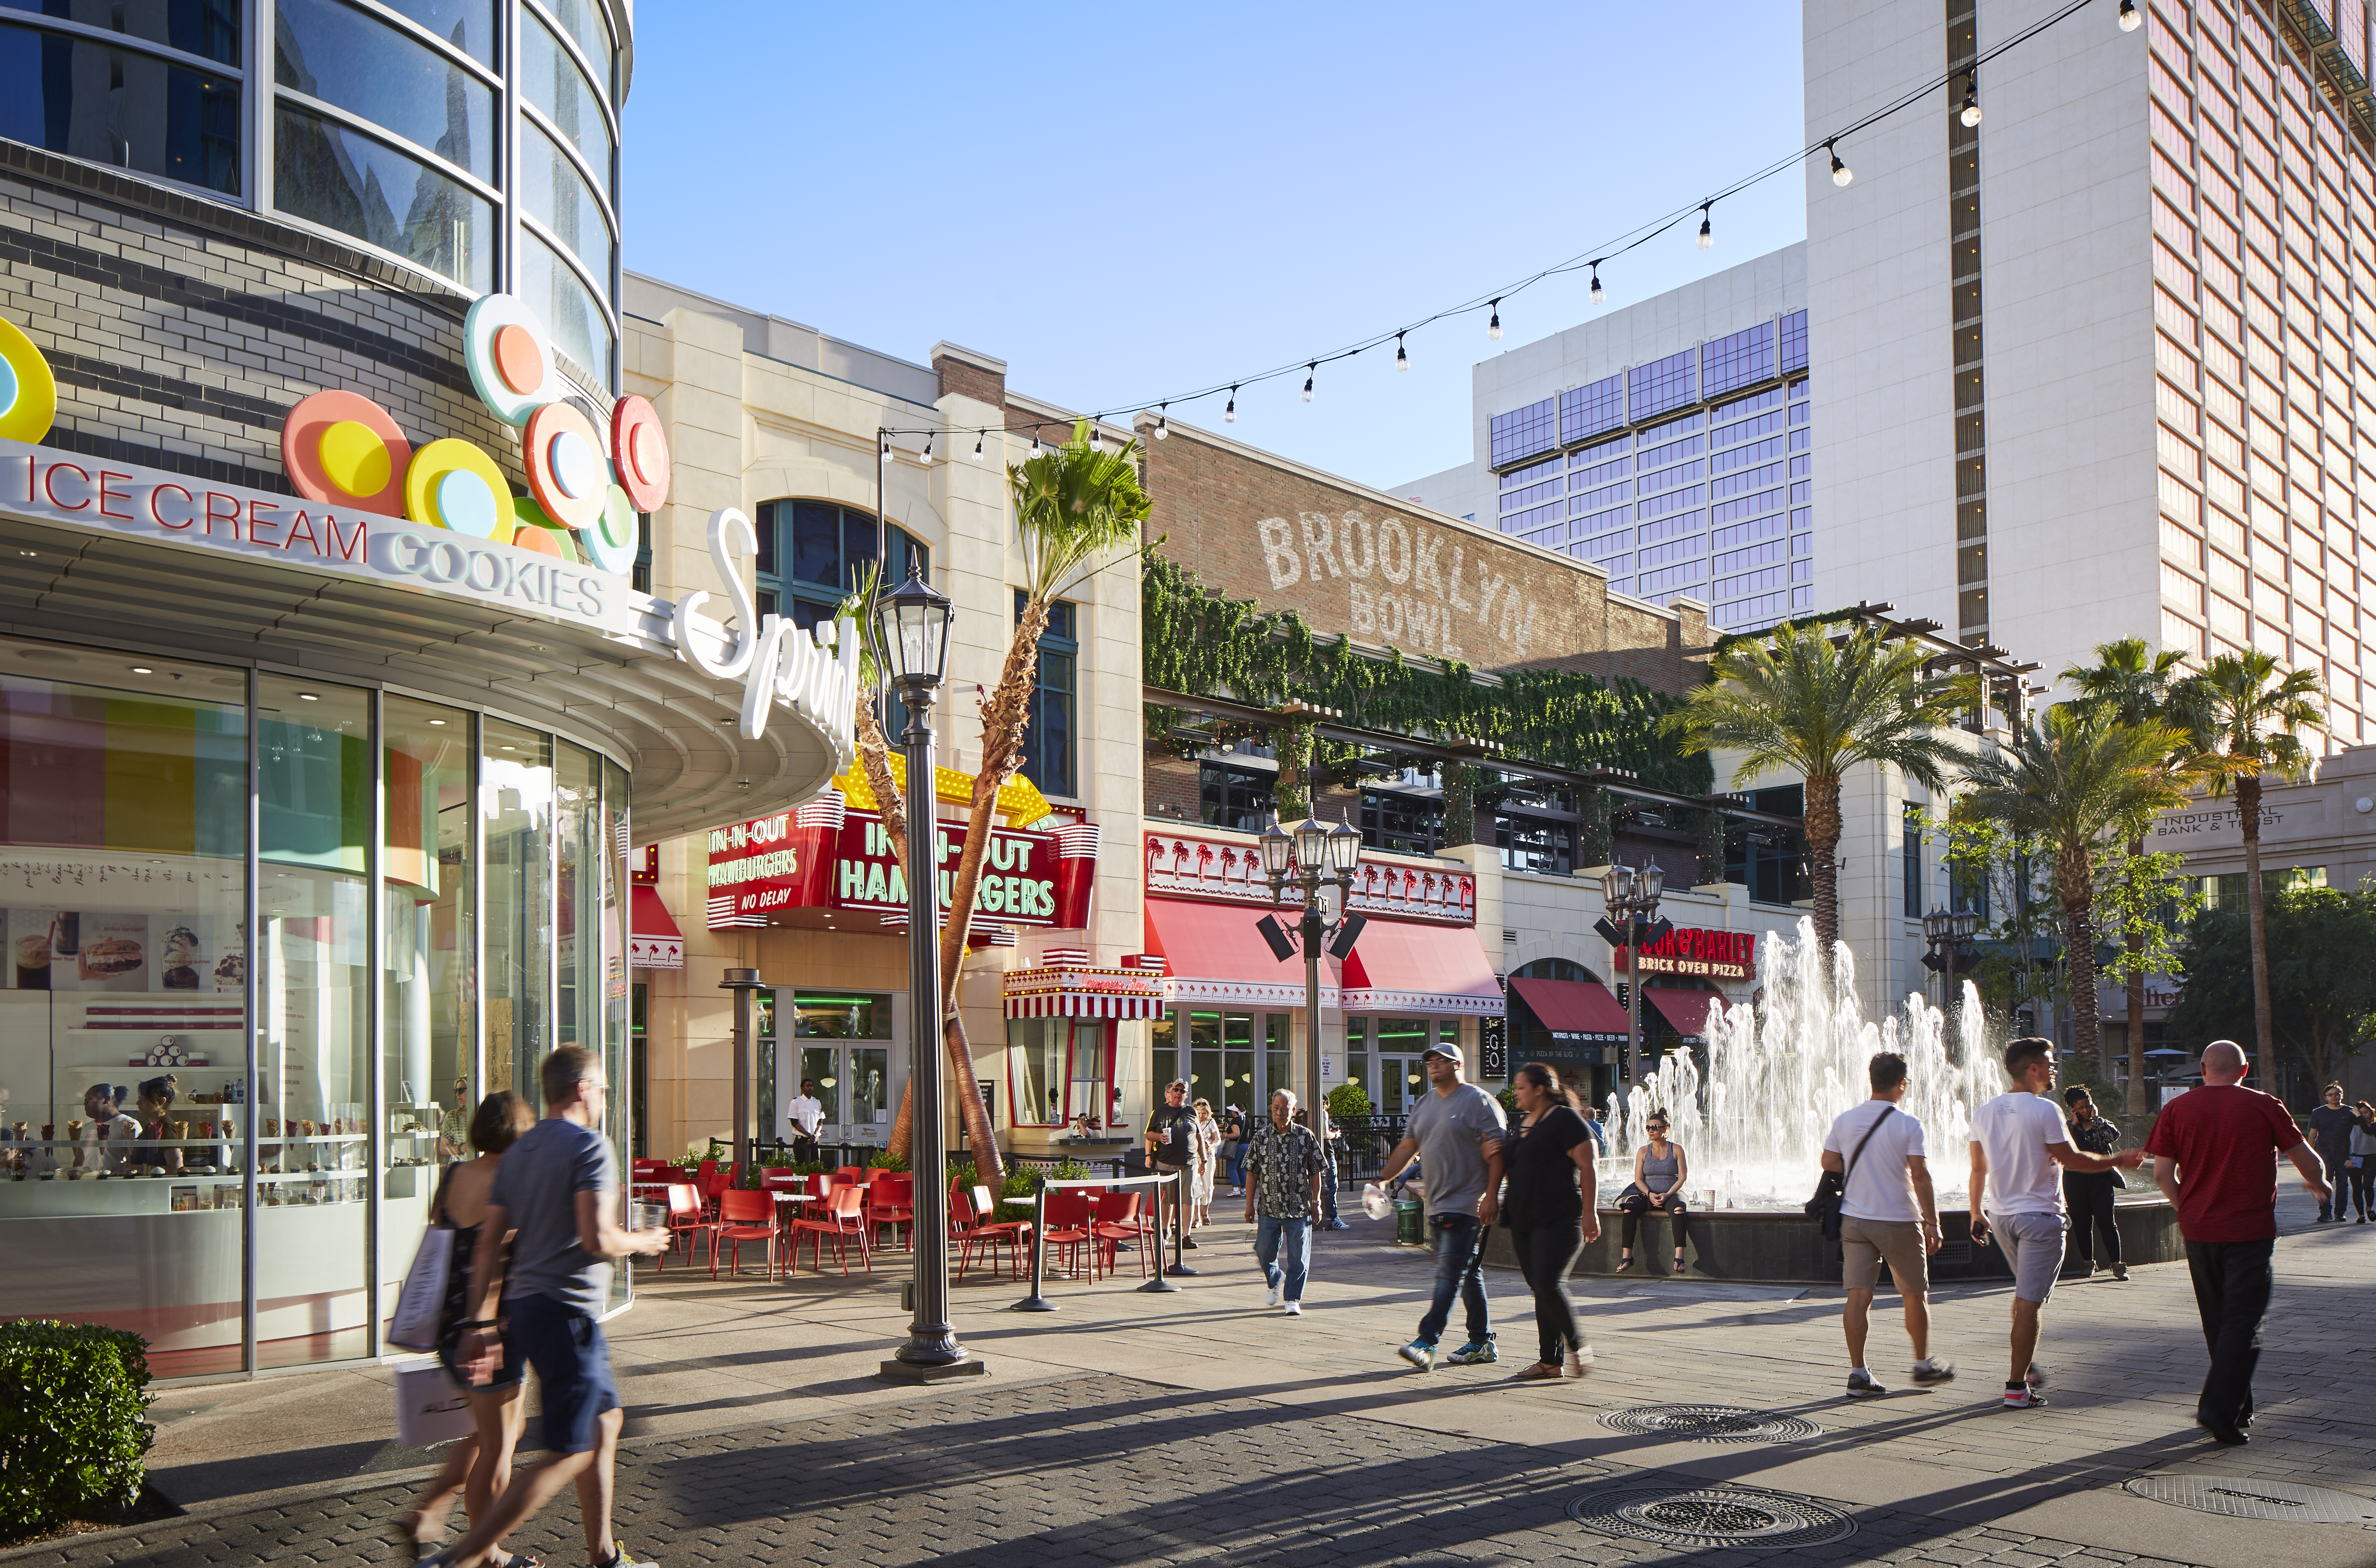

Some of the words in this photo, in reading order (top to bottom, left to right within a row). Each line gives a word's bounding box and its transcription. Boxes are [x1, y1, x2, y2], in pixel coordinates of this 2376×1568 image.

[29, 455, 134, 521] ICE
[151, 483, 367, 564] CREAM
[394, 531, 608, 617] COOKIES
[1256, 510, 1536, 657] BROOKLYN
[1350, 582, 1463, 658] BOWL
[708, 814, 789, 854] IN-N-OUT
[2158, 824, 2202, 836] BANK
[2210, 822, 2220, 831] &
[708, 848, 798, 888] HAMBURGERS
[742, 894, 756, 910] NO
[759, 887, 791, 907] DELAY
[841, 860, 1055, 916] HAMUGERS
[1677, 929, 1693, 954] &
[1692, 928, 1756, 963] BARLEY
[1082, 972, 1125, 995] Company
[1125, 975, 1150, 991] Store
[1638, 957, 1674, 972] BRICK
[1678, 960, 1708, 974] OVEN
[1712, 964, 1745, 978] PIZZA
[1490, 1034, 1499, 1068] GO
